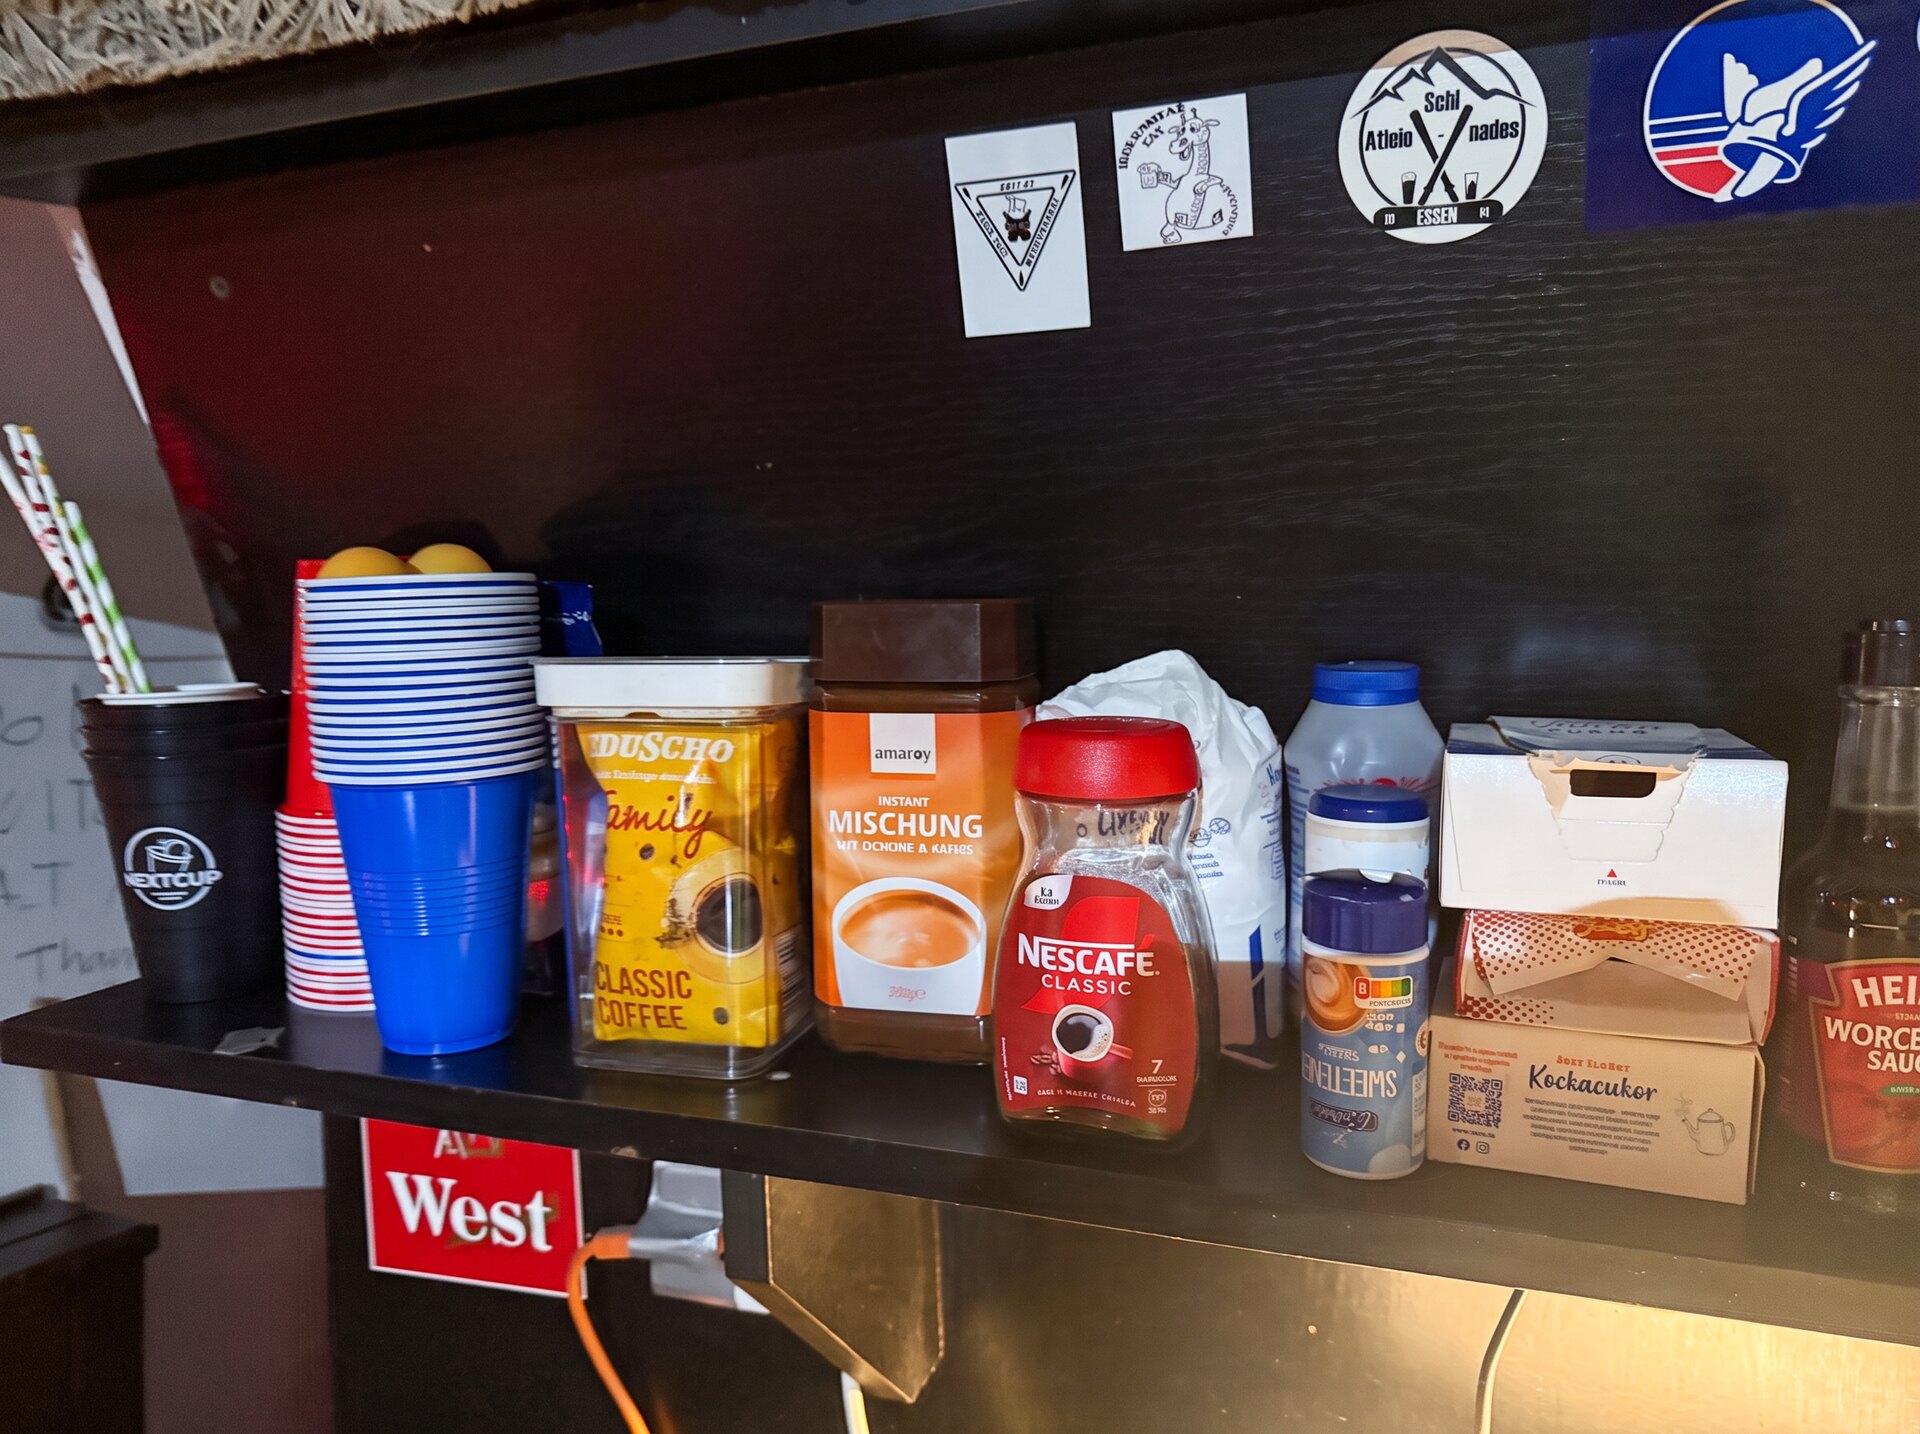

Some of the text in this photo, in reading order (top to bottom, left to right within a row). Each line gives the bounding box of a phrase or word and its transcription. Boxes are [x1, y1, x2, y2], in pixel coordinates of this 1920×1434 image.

[1424, 89, 1461, 113] Schl
[1469, 118, 1520, 142] nades
[1416, 206, 1459, 225] ESSEN
[875, 748, 931, 763] amaroy
[878, 796, 930, 808] INSTANT
[828, 809, 984, 839] MISCHUNG
[123, 870, 224, 889] NEXTCUP
[595, 960, 693, 999] CLASSIC
[1041, 973, 1133, 996] CLASSIC
[598, 996, 689, 1031] COFFEE
[1151, 1059, 1164, 1075] 7
[1528, 1064, 1658, 1102] Kockacukor
[385, 1171, 553, 1253] West
